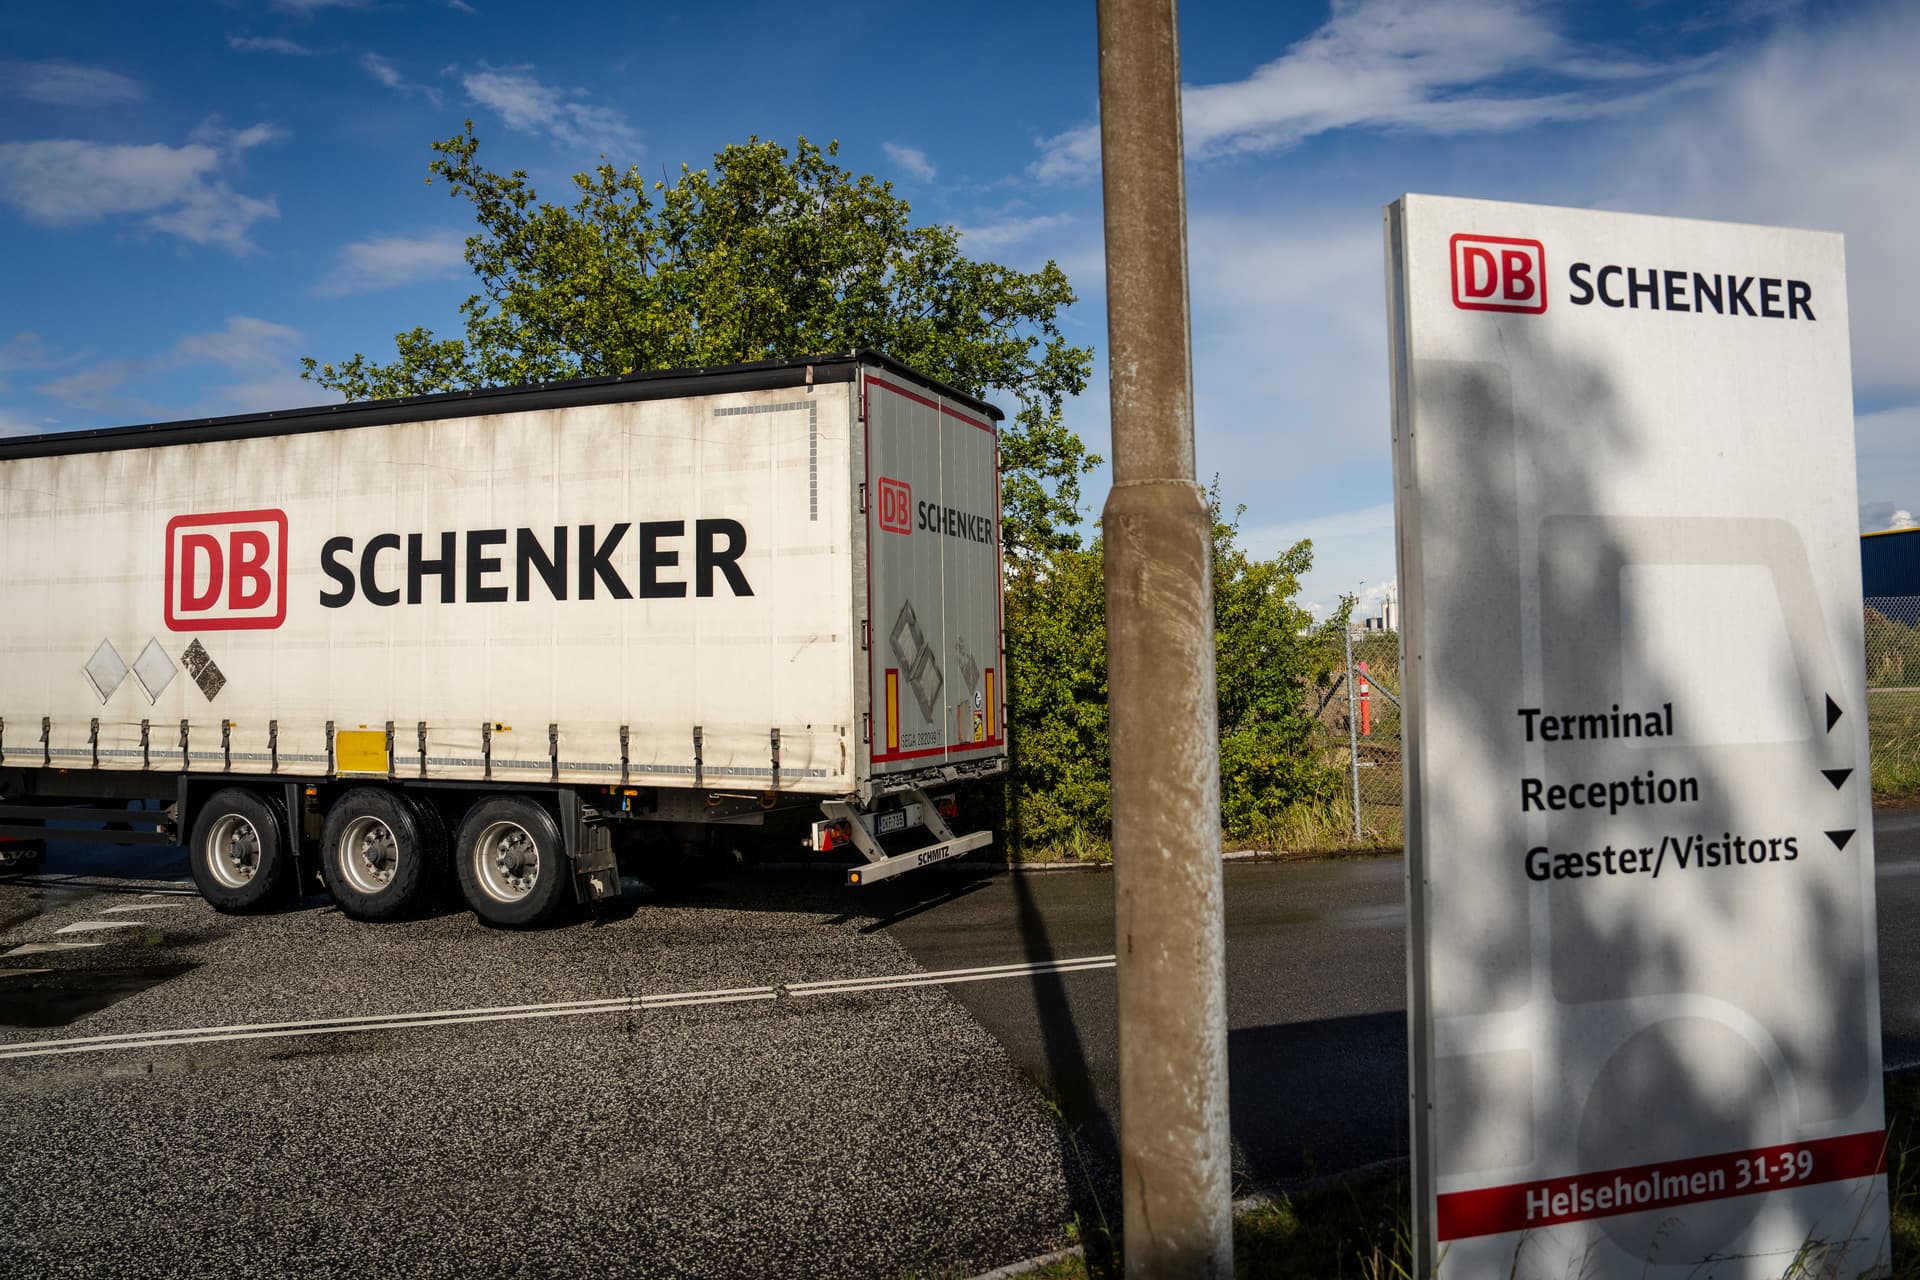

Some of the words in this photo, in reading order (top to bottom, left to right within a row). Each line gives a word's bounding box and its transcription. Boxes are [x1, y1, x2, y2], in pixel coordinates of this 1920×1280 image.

[1462, 247, 1536, 301] DB
[1569, 262, 1817, 321] SCHENKER
[883, 487, 908, 526] DB
[918, 500, 993, 545] SCHENKER
[180, 530, 272, 612] DB
[319, 518, 755, 609] SCHENKER
[1518, 702, 1674, 742] Terminal
[1521, 770, 1699, 815] Reception
[918, 845, 950, 866] SCHMITZ
[1525, 832, 1799, 881] Gæster/Visitors
[1526, 1166, 1725, 1220] Helseholmen
[1735, 1150, 1814, 1190] 31-39
